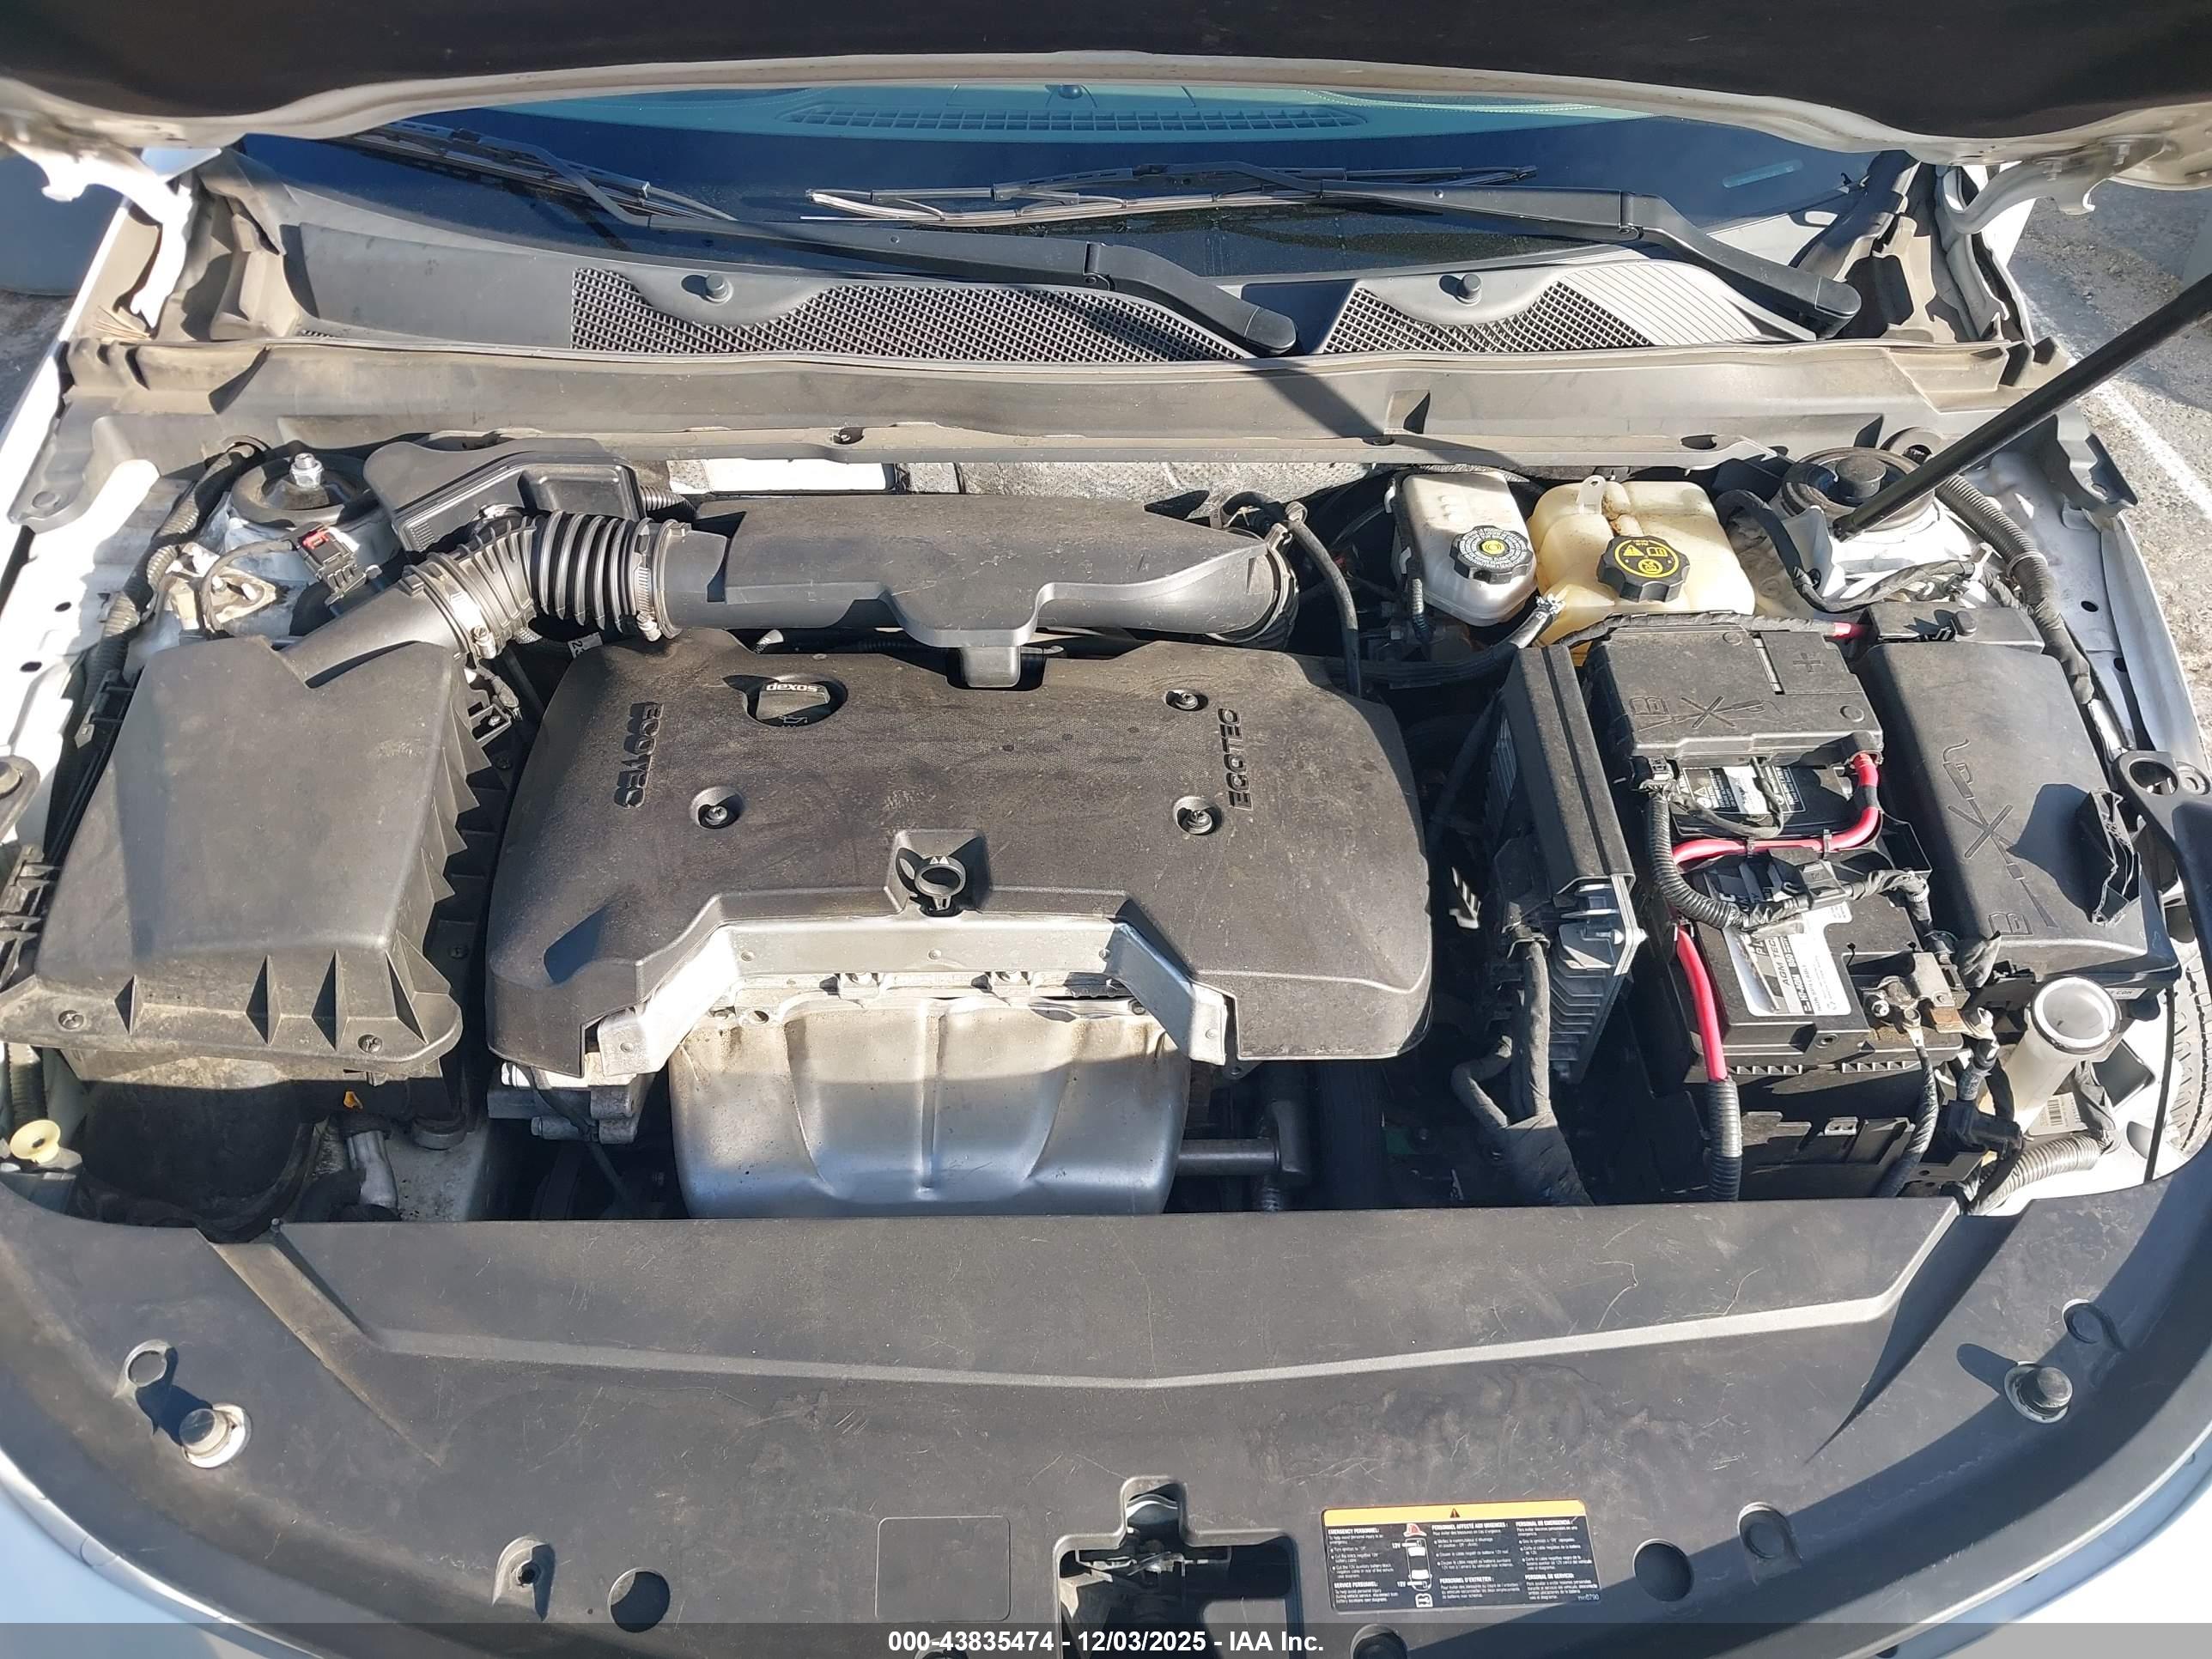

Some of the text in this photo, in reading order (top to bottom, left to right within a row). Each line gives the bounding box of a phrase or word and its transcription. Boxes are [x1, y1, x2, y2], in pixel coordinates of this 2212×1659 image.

[766, 683, 817, 692] dexos
[621, 702, 664, 809] ECOTEC
[1217, 708, 1254, 811] ECOTEC
[1776, 960, 1790, 987] AGM
